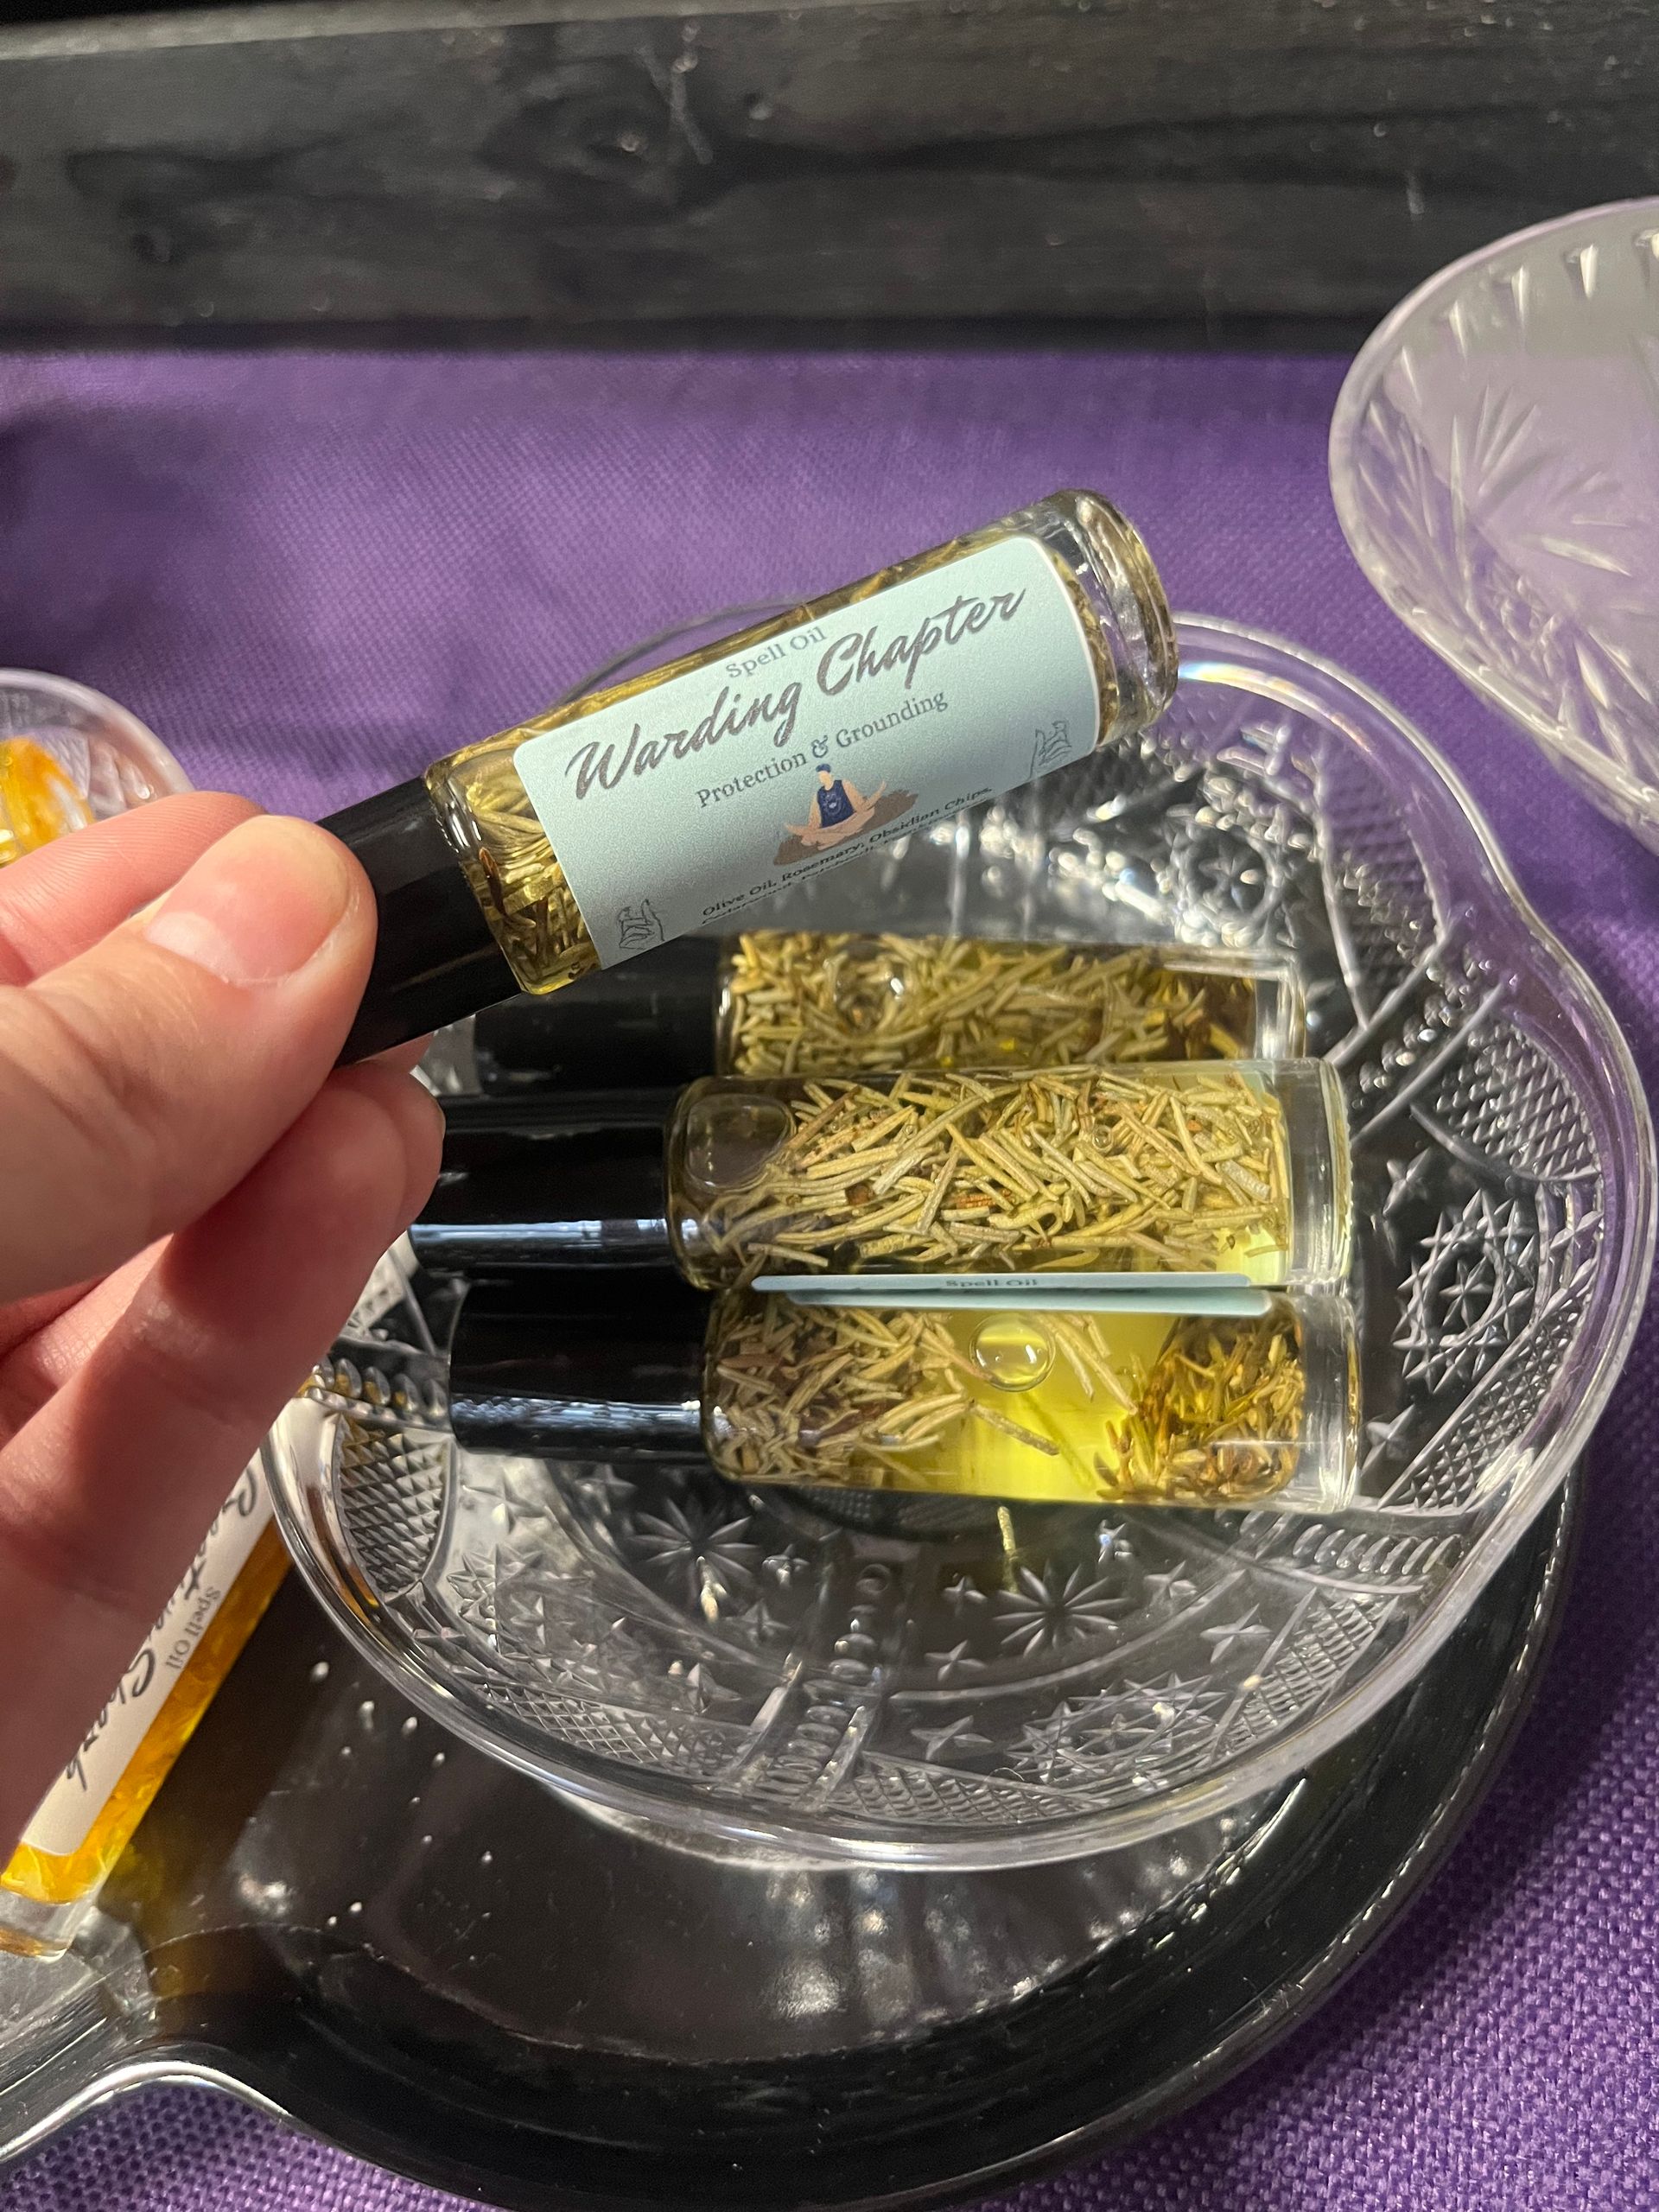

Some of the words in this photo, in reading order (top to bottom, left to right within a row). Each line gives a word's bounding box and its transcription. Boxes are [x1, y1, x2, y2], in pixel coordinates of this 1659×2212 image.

[726, 643, 785, 679] Spell
[790, 626, 827, 651] Oil
[564, 681, 803, 800] Warding
[817, 588, 1027, 696] Chapter
[696, 748, 808, 809] Protection
[810, 735, 830, 759] &
[836, 692, 950, 751] Grounding
[702, 892, 745, 916] Olive
[869, 809, 940, 843] Obsidian
[945, 1279, 999, 1287] Spell
[185, 1586, 221, 1638] Spell
[165, 1639, 191, 1670] Oil
